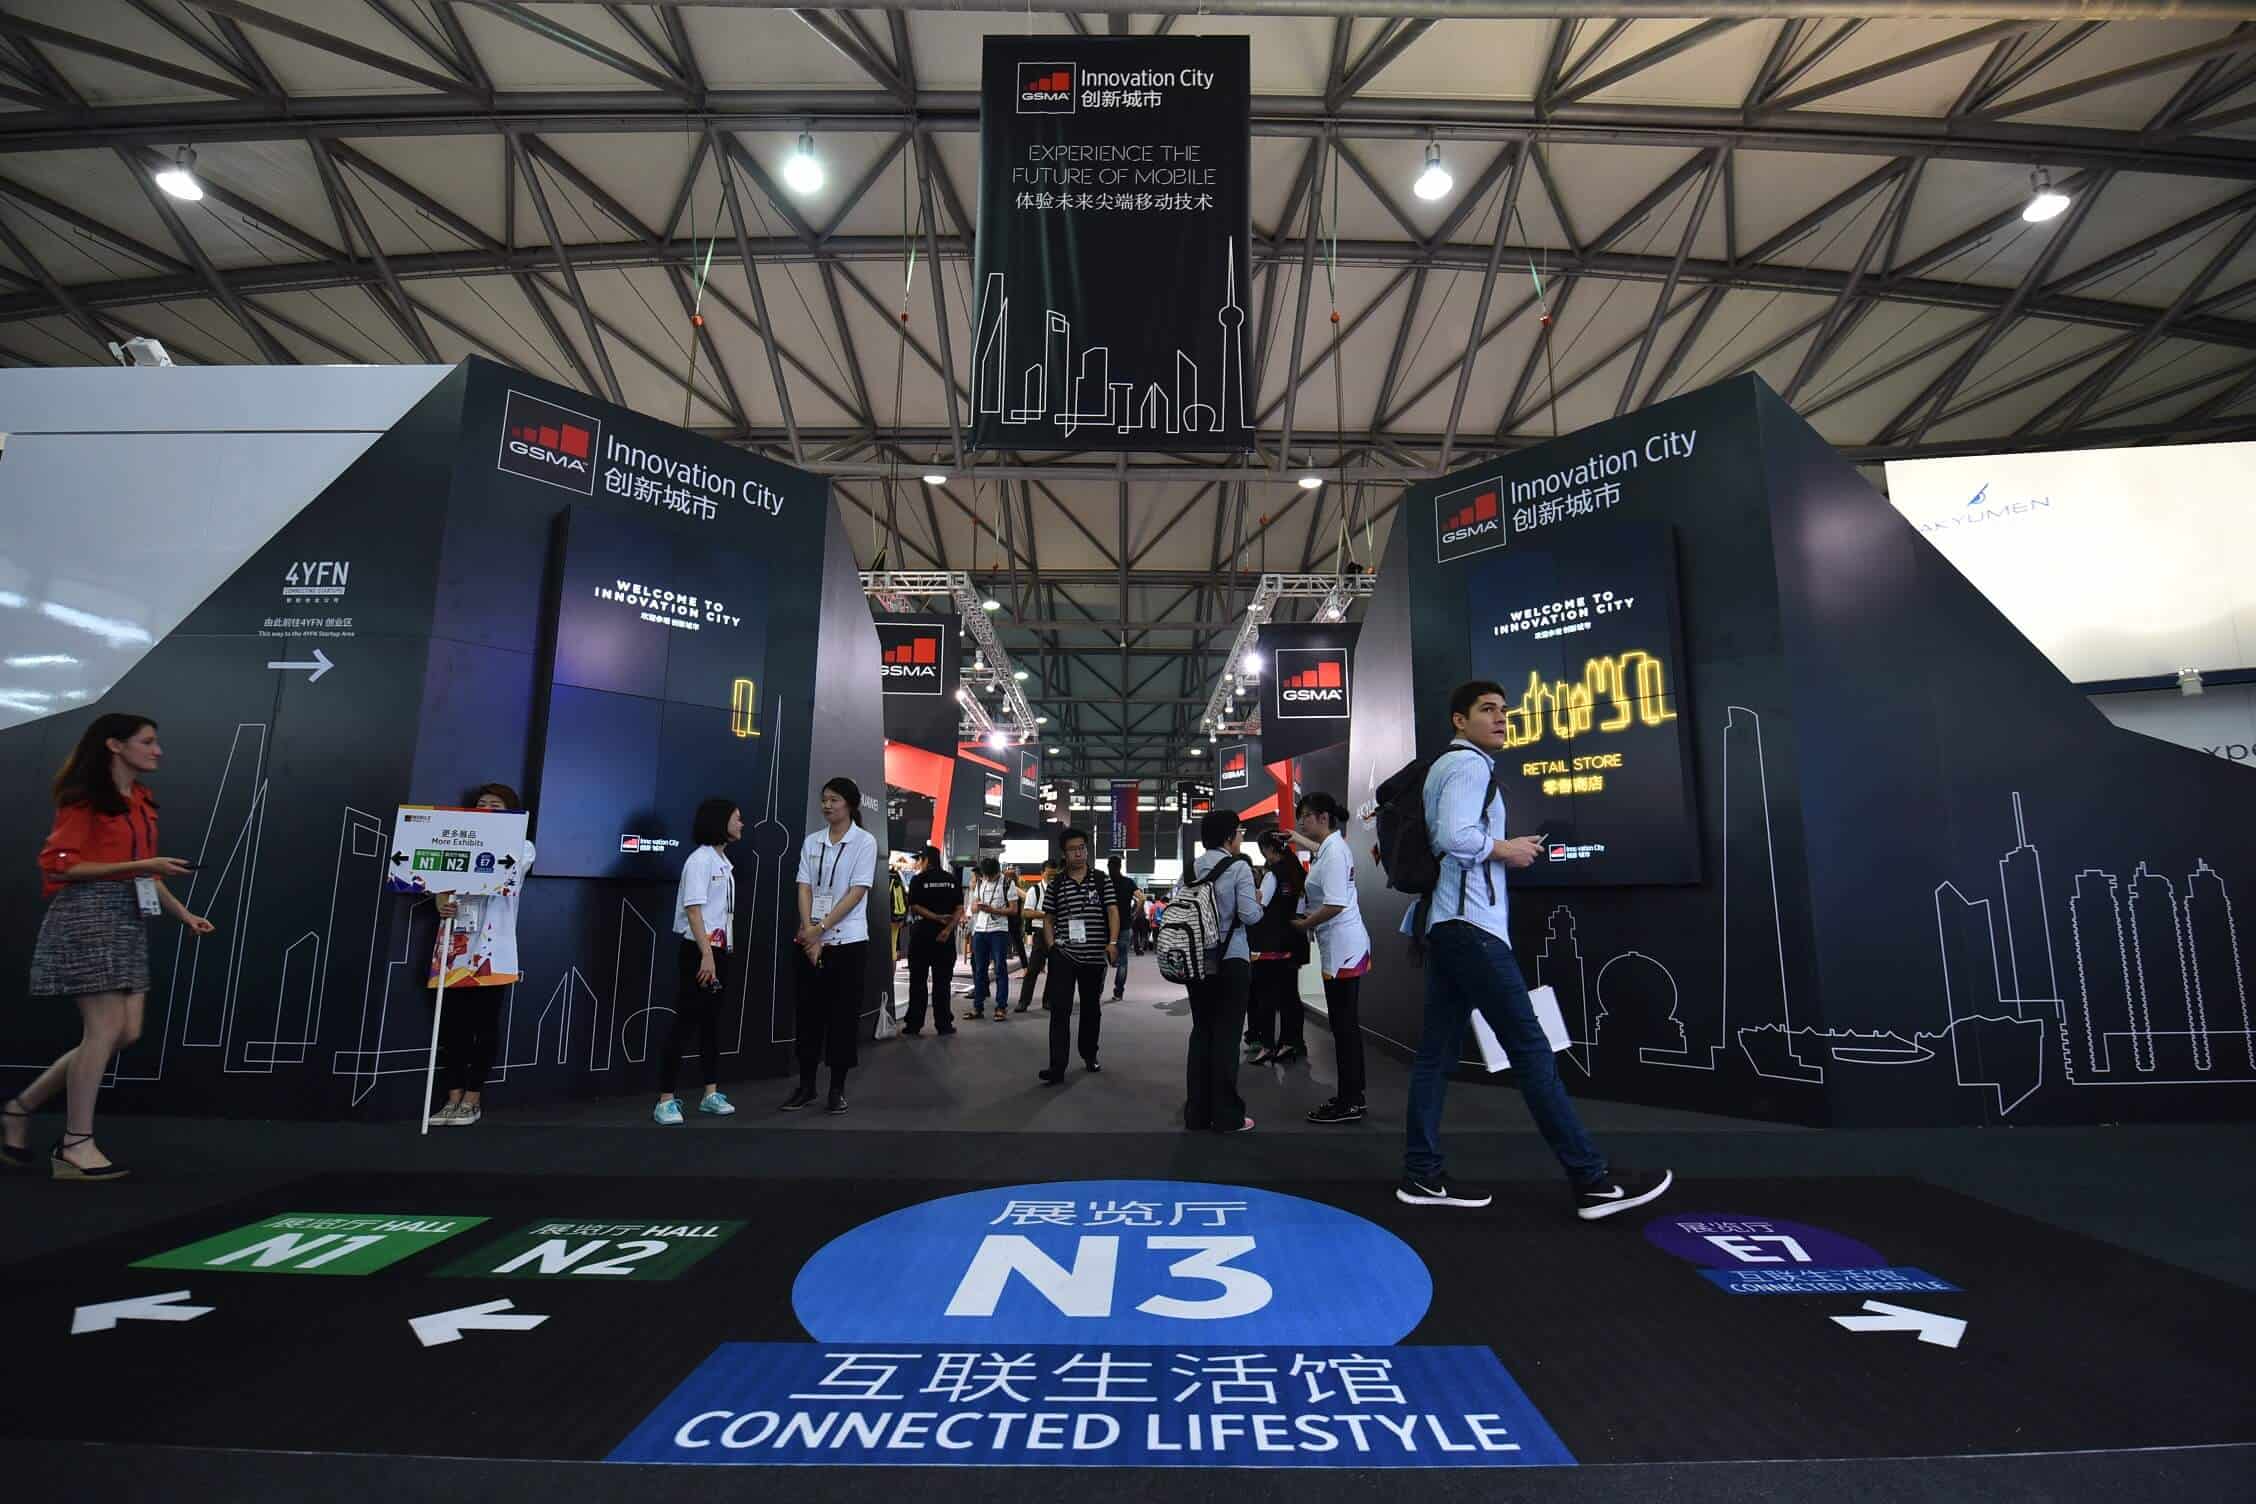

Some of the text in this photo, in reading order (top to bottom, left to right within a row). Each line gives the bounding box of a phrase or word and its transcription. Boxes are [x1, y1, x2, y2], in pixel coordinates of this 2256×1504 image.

[1081, 69, 1214, 90] Innovation City
[1022, 92, 1070, 101] GSMA
[1081, 90, 1162, 108] 创新城市
[1029, 145, 1200, 161] EXPERIENCE THE
[1012, 168, 1216, 184] FUTURE OF MOBILE
[1015, 192, 1214, 210] 体验未来尖端移动技术
[509, 441, 586, 473] GSMA
[1511, 430, 1696, 504] Innovation City
[607, 434, 784, 515] Innovation City
[604, 467, 718, 520] 创新城市
[1513, 482, 1621, 533] 创新城市
[1442, 520, 1498, 544] GSMA
[286, 562, 349, 586] 4YFN
[595, 587, 740, 627] INNOVATION CITY
[617, 580, 724, 612] WELCOME TO
[1510, 591, 1613, 621] WELCOME TO
[1494, 598, 1634, 635] INNOVATION CITY
[1283, 689, 1342, 701] GSMA
[1523, 753, 1623, 776] RETAIL STORE
[432, 838, 484, 848] More Exhibits
[420, 857, 434, 869] N1
[447, 858, 465, 870] N2
[988, 1200, 1248, 1226] 展览厅
[371, 1220, 456, 1233] HALL
[640, 1225, 719, 1238] HALL
[203, 1233, 388, 1268] N1
[490, 1239, 669, 1275] N2
[1703, 1235, 1813, 1262] E7
[944, 1235, 1272, 1320] N3
[1730, 1281, 1952, 1293] CONNECTED LIFESTYLE
[789, 1351, 1408, 1405] 互联生活馆
[674, 1411, 1521, 1453] CONNECTED LIFESTYLE
